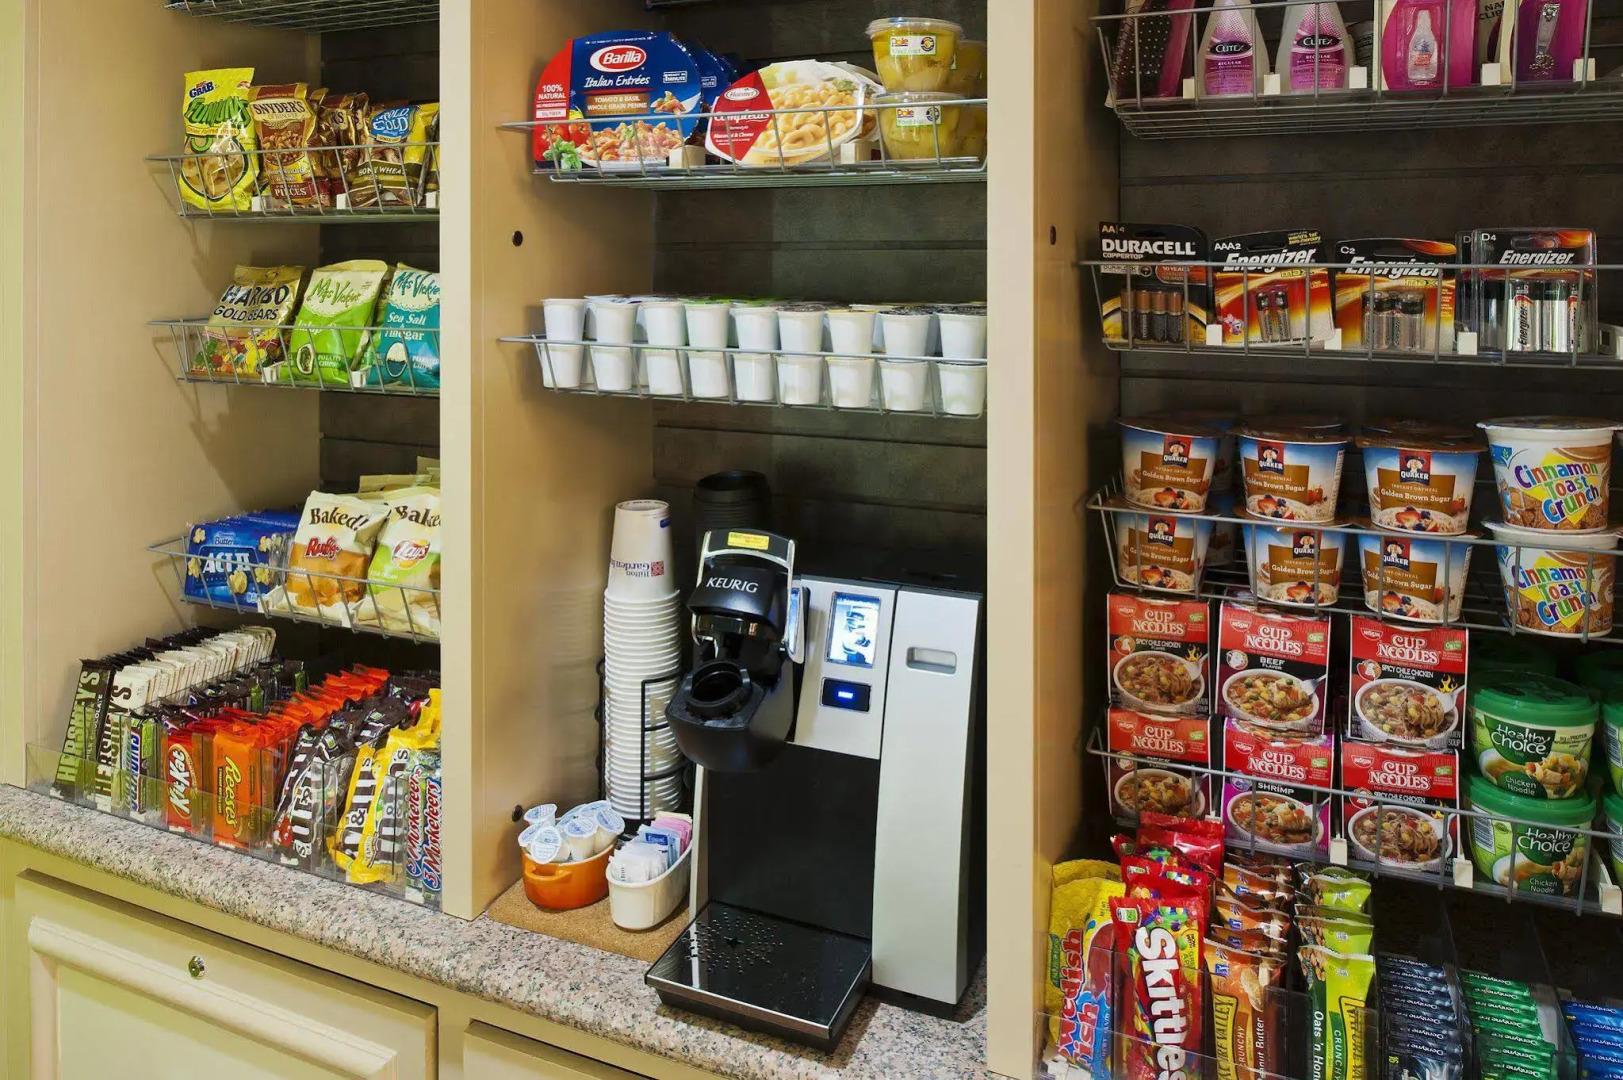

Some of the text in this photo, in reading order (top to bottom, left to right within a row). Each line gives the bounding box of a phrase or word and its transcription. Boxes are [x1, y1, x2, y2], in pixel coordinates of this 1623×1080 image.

[892, 37, 908, 45] Dole
[602, 50, 642, 65] Barilla
[542, 84, 563, 92] 100%
[584, 74, 650, 89] Italian Entrées
[189, 82, 215, 99] GRAB
[538, 92, 566, 101] NATURAL
[253, 101, 306, 116] SNYDER'S
[897, 109, 914, 117] Dole
[1102, 225, 1116, 233] AA
[1102, 239, 1196, 256] DURACELL
[1102, 252, 1144, 260] COPPERTOP
[1223, 248, 1316, 273] Energizer
[1499, 250, 1575, 265] Energizer
[1345, 256, 1443, 279] Energizer
[221, 283, 290, 307] HARIBO
[387, 312, 427, 326] Sea Salt
[1517, 305, 1529, 346] Energizer
[1163, 453, 1188, 464] QUAKER
[1258, 459, 1284, 471] QUAKER
[1142, 470, 1202, 485] Golden Brown Sugar
[1401, 470, 1429, 482] QUAKER
[1514, 461, 1598, 490] Cinnamon
[1263, 480, 1306, 492] Brown Sugar
[1544, 476, 1588, 498] Toast
[1381, 487, 1451, 503] Golden Brown Sugar
[1541, 484, 1600, 524] Crunch
[309, 507, 369, 531] Baked!
[214, 536, 234, 546] Butter
[1148, 531, 1173, 542] QUAKER
[203, 551, 233, 574] ACT
[1151, 552, 1189, 563] Brown Sugar
[615, 561, 650, 572] Garden
[626, 570, 650, 578] Hilton
[1271, 564, 1335, 575] Golden Sugar
[706, 576, 760, 593] KEURIG
[1386, 576, 1433, 590] Brown Sugar
[1537, 581, 1584, 601] Toast
[1144, 610, 1174, 624] CUP
[1132, 620, 1186, 636] NOODLES
[1259, 626, 1292, 642] CUP
[1244, 636, 1304, 657] NOODLES
[1391, 634, 1427, 650] CUP
[1260, 656, 1285, 667] BEEF
[1376, 643, 1439, 665] NOODLES
[1381, 664, 1395, 673] SPICY
[1411, 669, 1434, 678] CHICKEN
[1144, 726, 1174, 739] CUP
[1497, 724, 1550, 744] Healthy
[1131, 735, 1186, 753] NOODLES
[1491, 730, 1546, 755] Choice
[1262, 750, 1296, 766] CUP
[1248, 758, 1307, 781] NOODLES
[1383, 760, 1418, 776] CUP
[1257, 782, 1294, 795] SHRIMP
[1368, 772, 1431, 790] NOODLES
[1505, 776, 1537, 788] Chicken
[224, 755, 243, 828] Reese's
[1507, 784, 1535, 796] Noodle
[421, 779, 442, 873] Musketeers
[1526, 827, 1579, 844] Healthy
[1517, 836, 1571, 853] Choice
[1529, 877, 1558, 887] Chicken
[1530, 885, 1555, 894] Noodle
[1313, 1011, 1325, 1037] Oats
[1256, 1017, 1264, 1048] Butter
